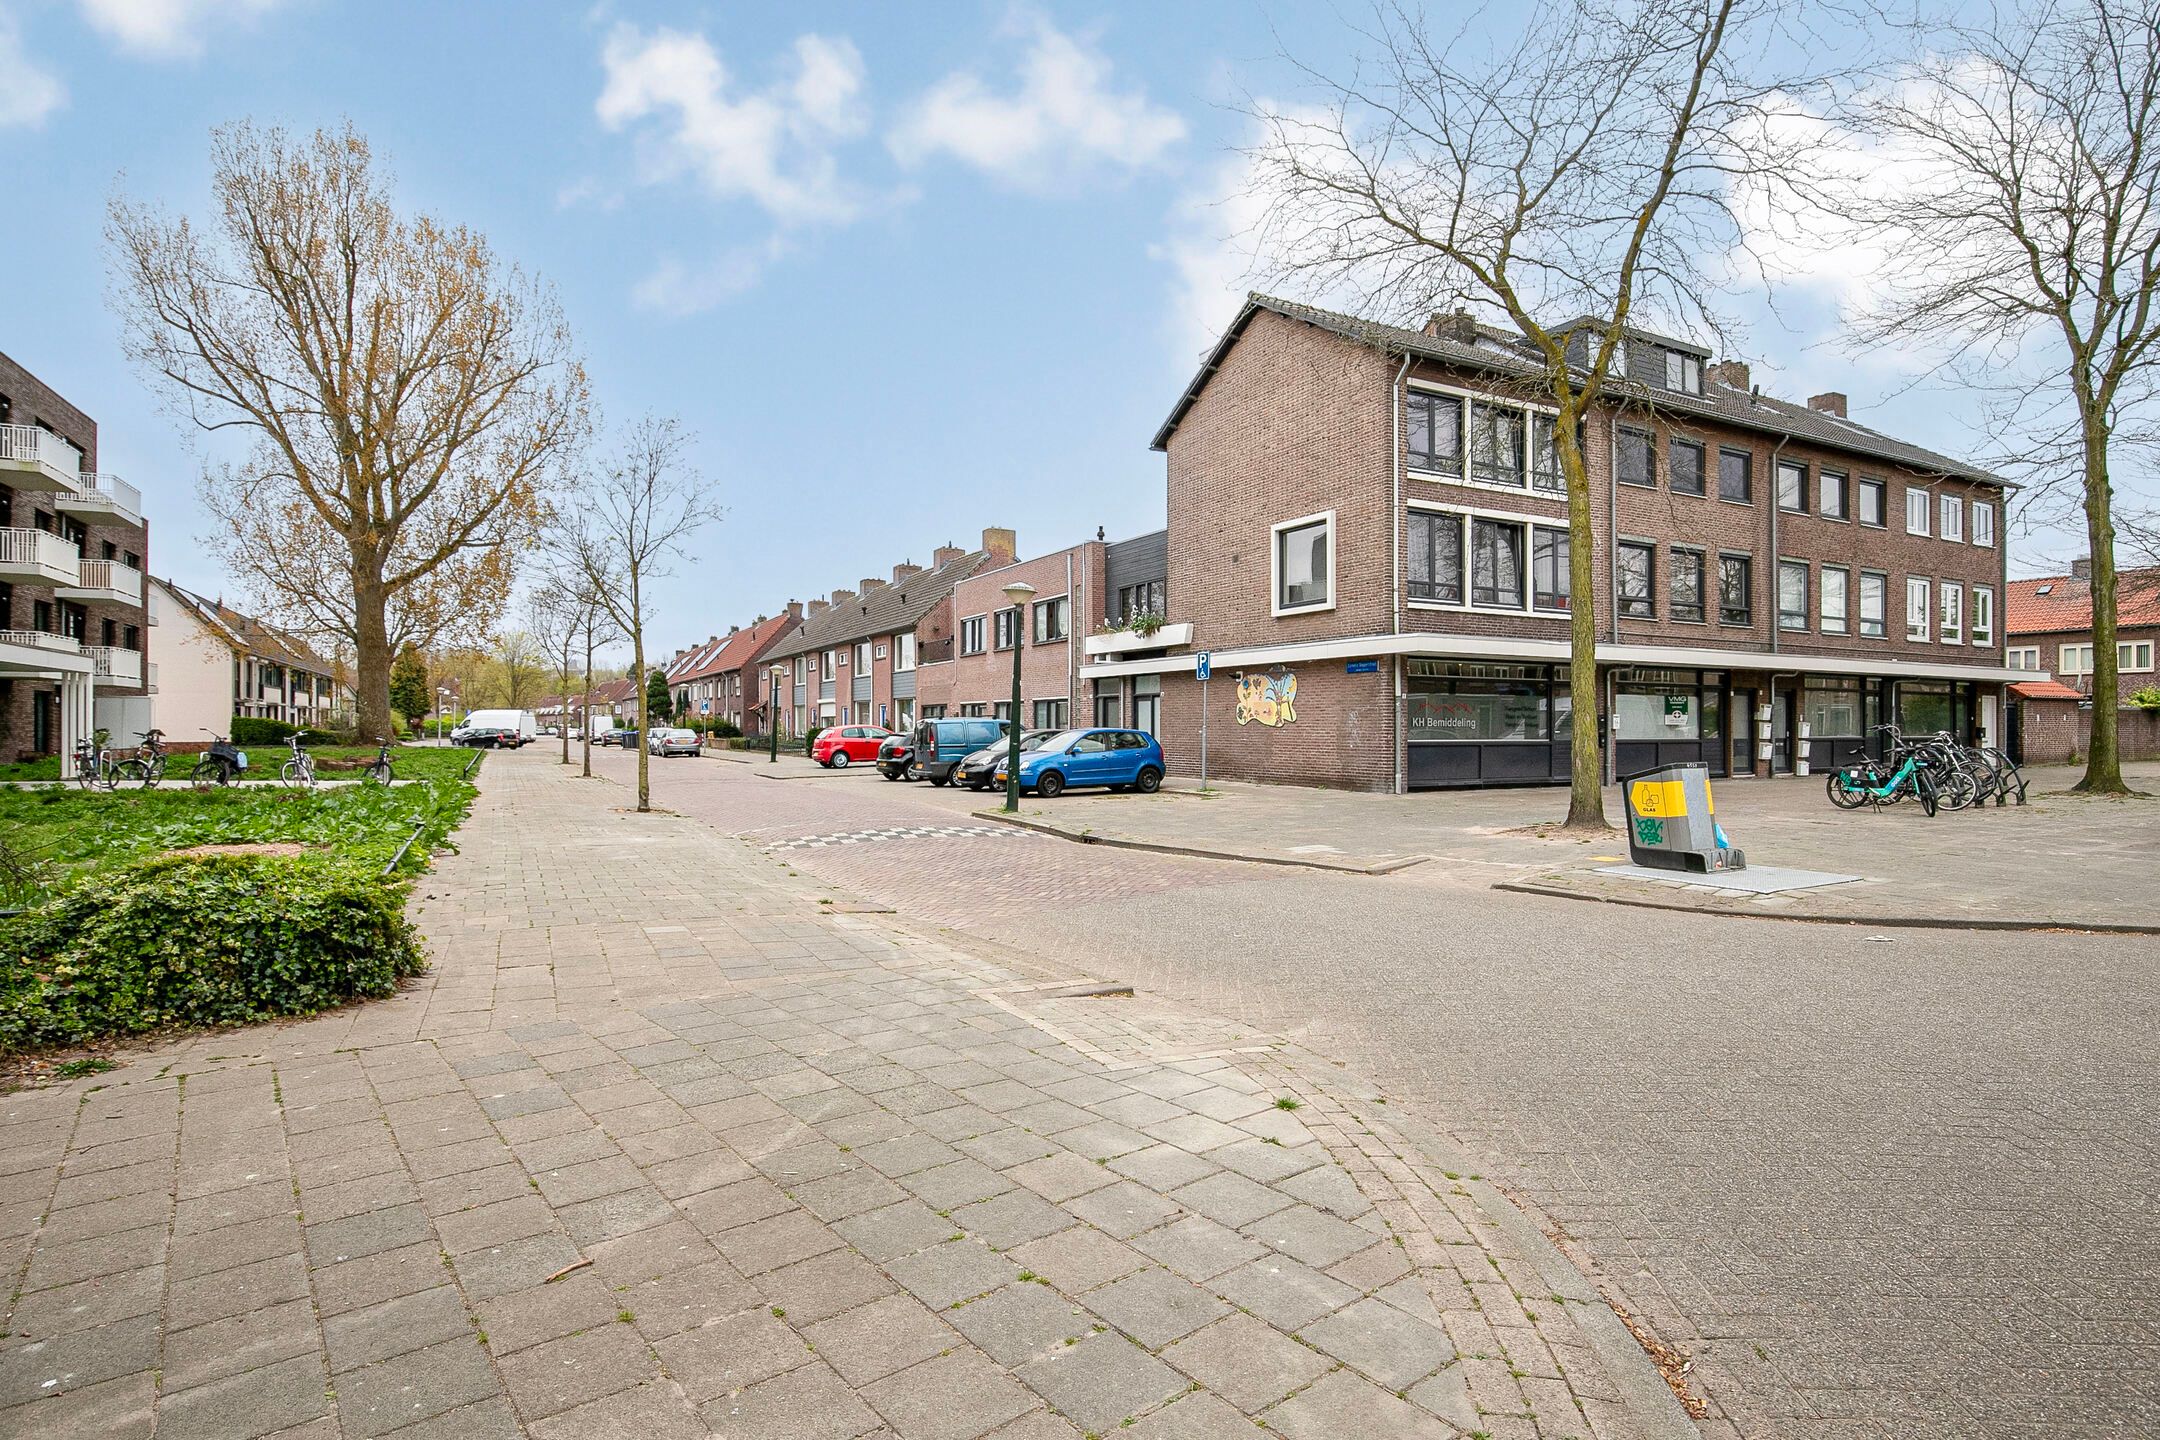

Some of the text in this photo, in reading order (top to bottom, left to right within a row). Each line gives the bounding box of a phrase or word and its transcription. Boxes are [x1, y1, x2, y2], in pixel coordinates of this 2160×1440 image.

[1200, 655, 1207, 668] P
[1412, 717, 1476, 729] KH Bemiddeling
